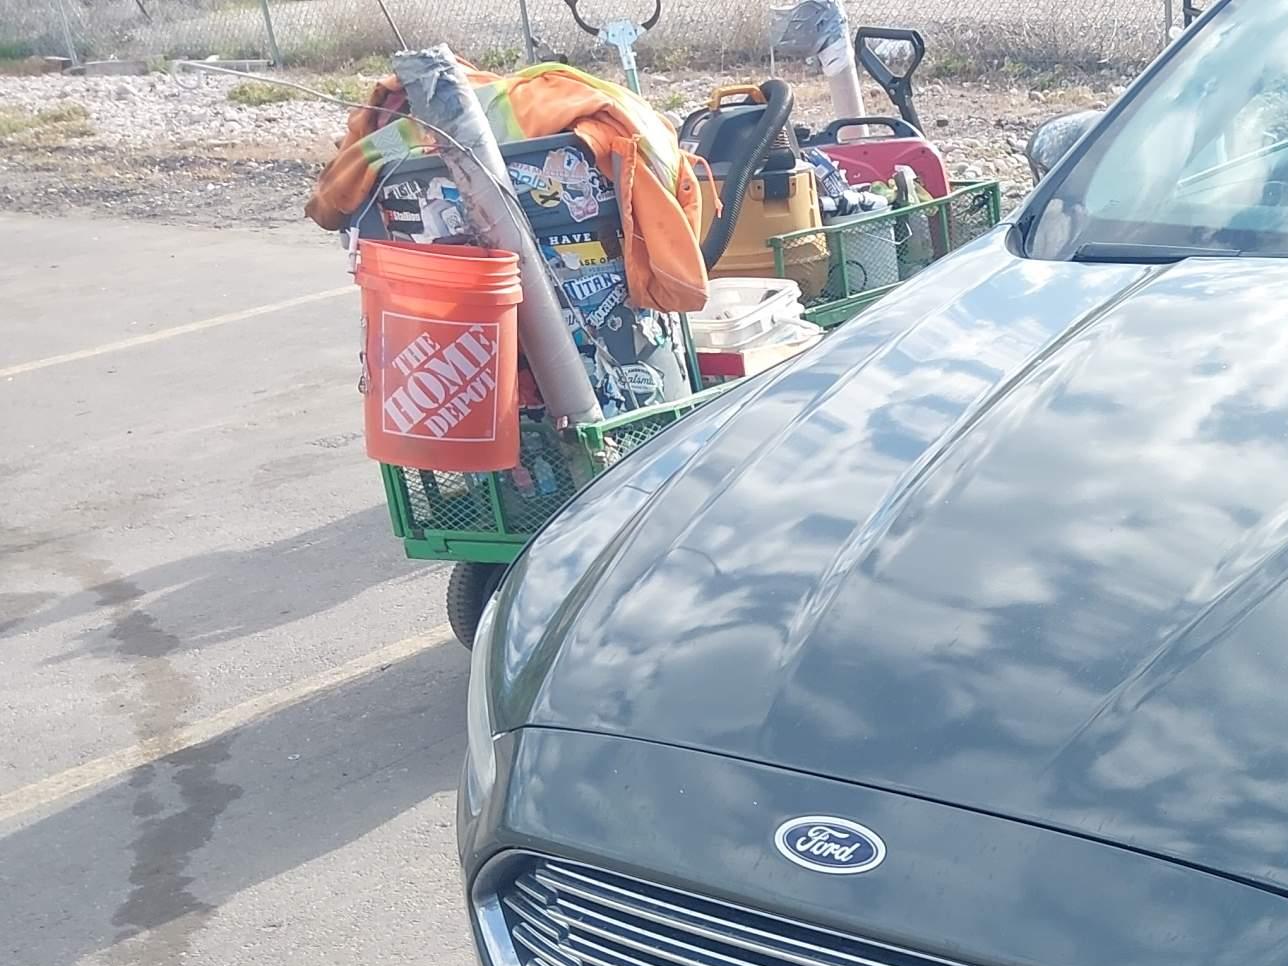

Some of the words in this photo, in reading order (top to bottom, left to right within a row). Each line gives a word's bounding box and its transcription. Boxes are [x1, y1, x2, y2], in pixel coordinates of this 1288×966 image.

[548, 233, 592, 246] HAVE
[391, 331, 440, 376] THE
[384, 324, 498, 433] HOME
[423, 367, 496, 438] DEPOT
[796, 826, 860, 862] Ford
